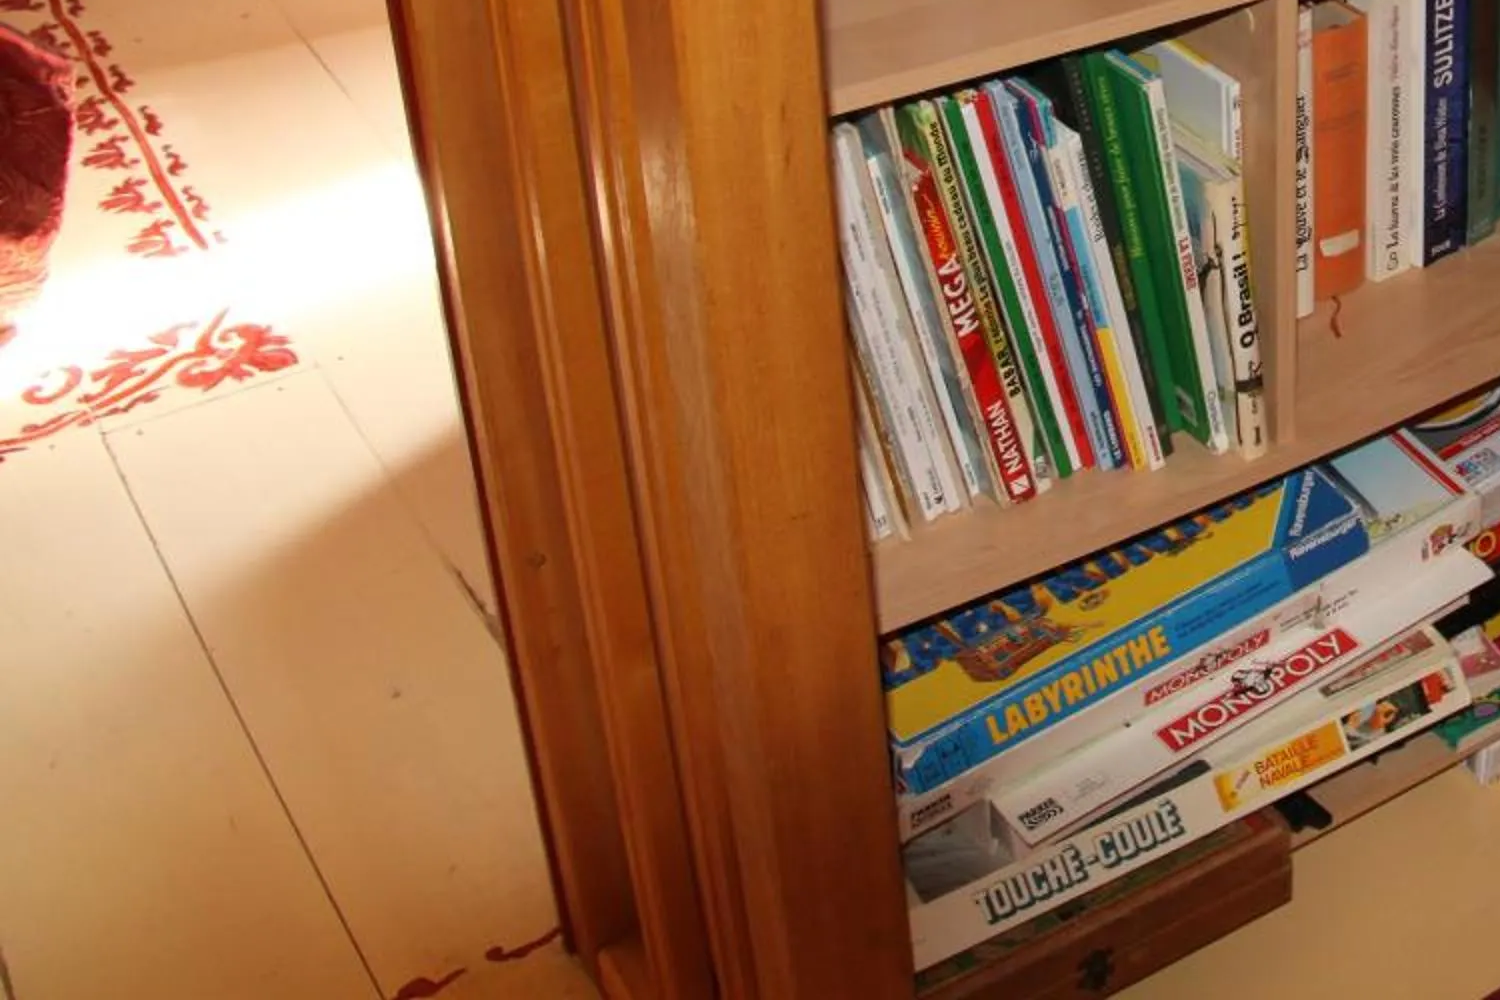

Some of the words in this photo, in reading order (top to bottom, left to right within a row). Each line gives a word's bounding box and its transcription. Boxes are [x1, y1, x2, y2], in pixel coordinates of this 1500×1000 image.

[928, 120, 948, 165] Monde
[941, 166, 955, 183] du
[947, 184, 969, 228] cadeau
[962, 229, 978, 261] beau
[938, 252, 981, 338] MEGA
[1232, 263, 1254, 327] Brasil
[996, 351, 1022, 397] BABAR
[988, 401, 1024, 473] NATHAN
[984, 624, 1173, 746] LABYRINTHE
[1165, 635, 1349, 748] MONOPOLY
[1254, 732, 1320, 776] BATAILLE
[1259, 750, 1316, 790] NAVALE
[975, 797, 1187, 926] TOUCHÉ-COULÉ
